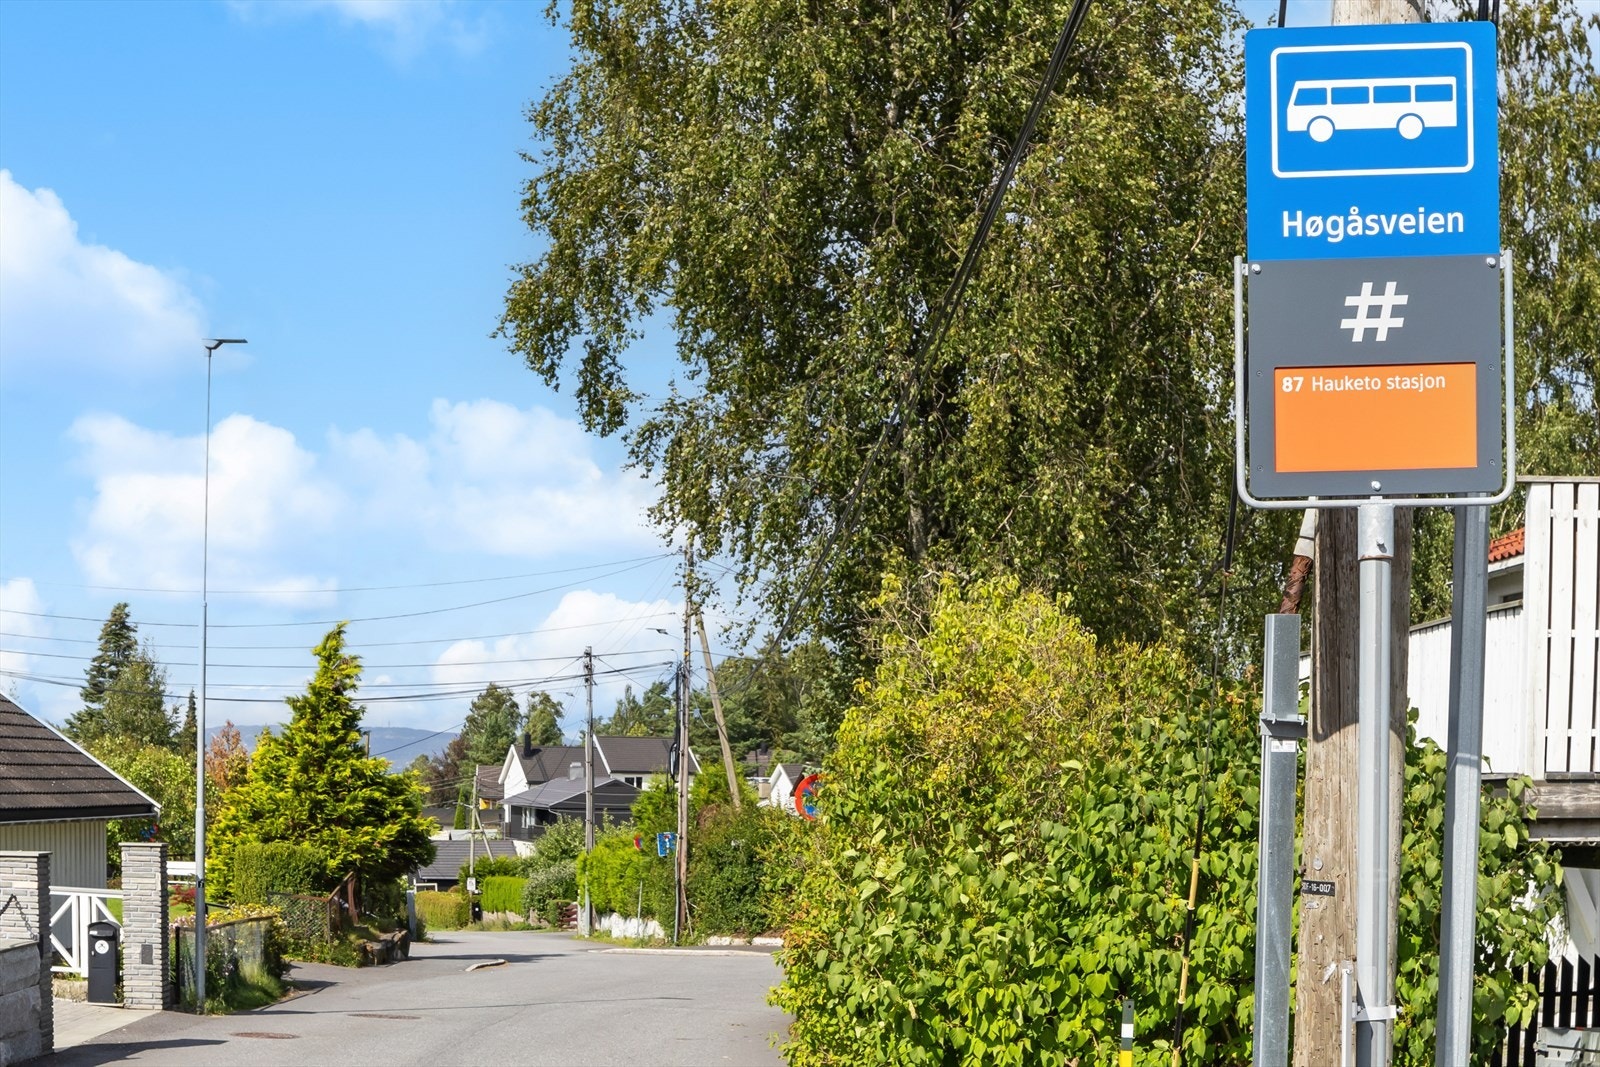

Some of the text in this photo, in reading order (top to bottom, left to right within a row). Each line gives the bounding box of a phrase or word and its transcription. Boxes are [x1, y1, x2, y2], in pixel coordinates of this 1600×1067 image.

[1282, 206, 1465, 243] Høgåsveien
[1281, 373, 1446, 392] 87 Hauketo stasjon
